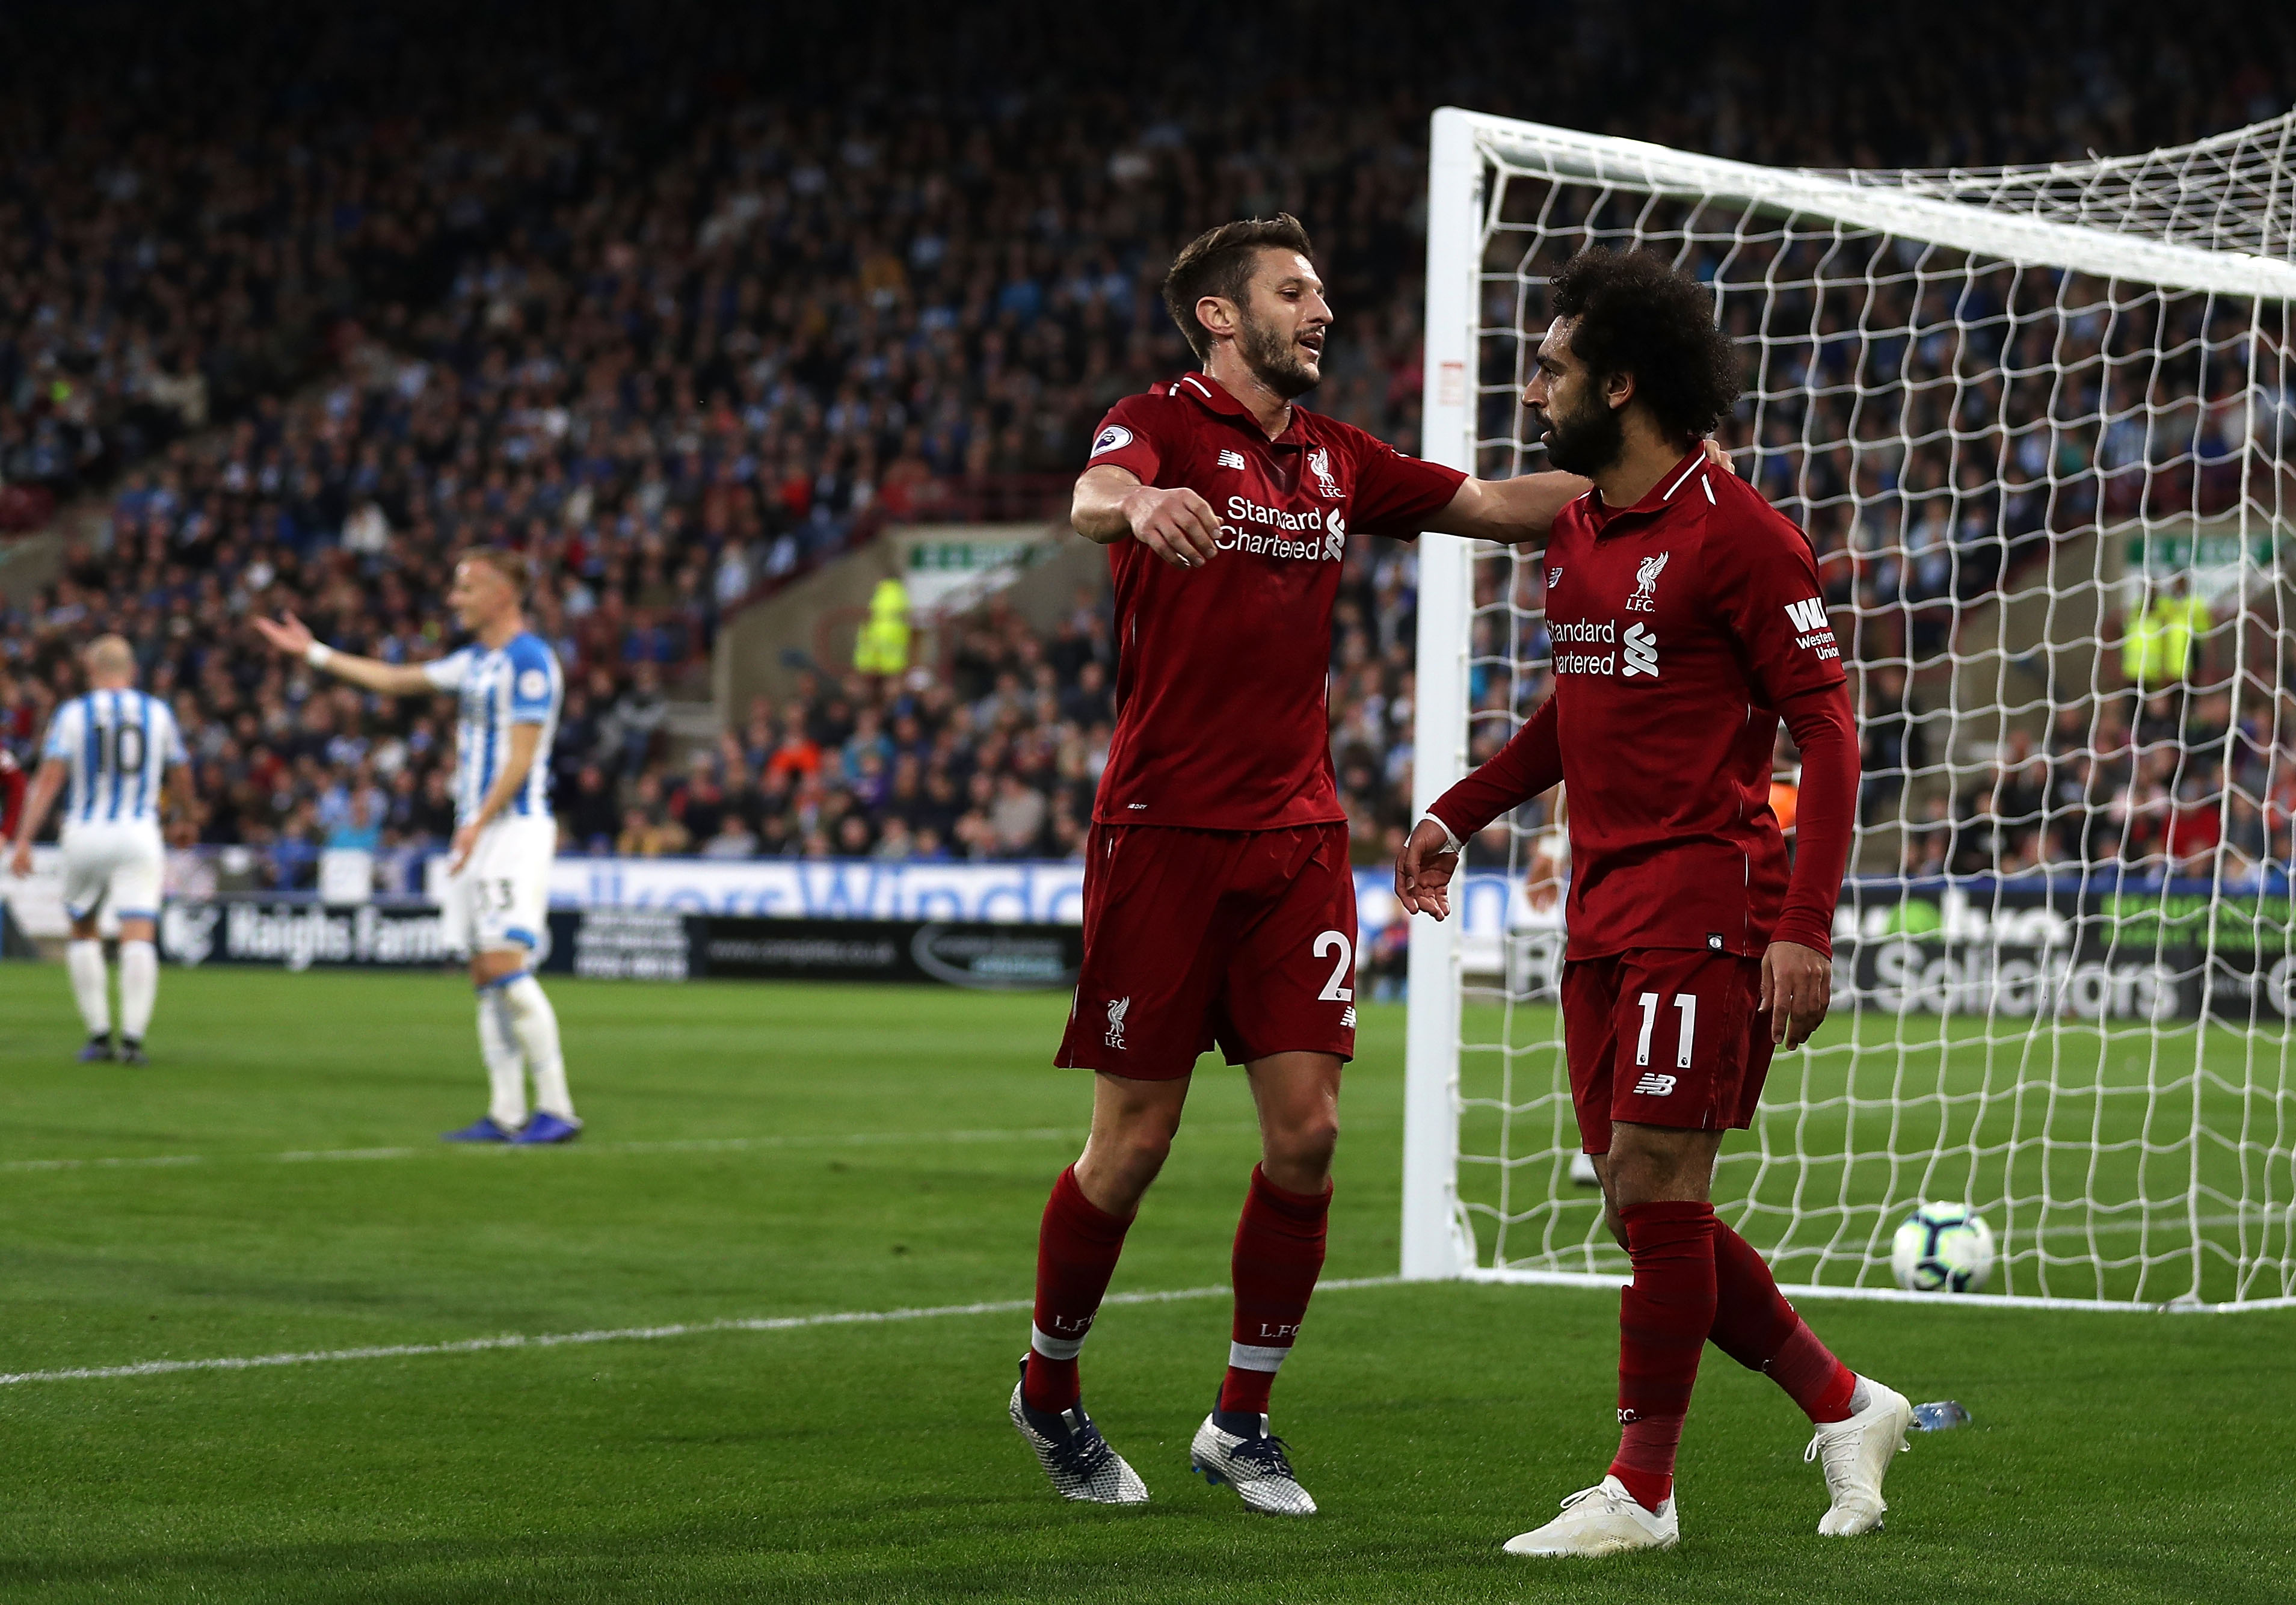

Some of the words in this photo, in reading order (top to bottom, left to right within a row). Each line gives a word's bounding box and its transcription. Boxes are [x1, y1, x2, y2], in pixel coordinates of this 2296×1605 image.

[1215, 525, 1320, 560] Chartered
[94, 722, 146, 775] 10
[1313, 929, 1353, 1002] 2
[1873, 941, 2181, 1021] Solicitors
[1636, 991, 1697, 1070] 11
